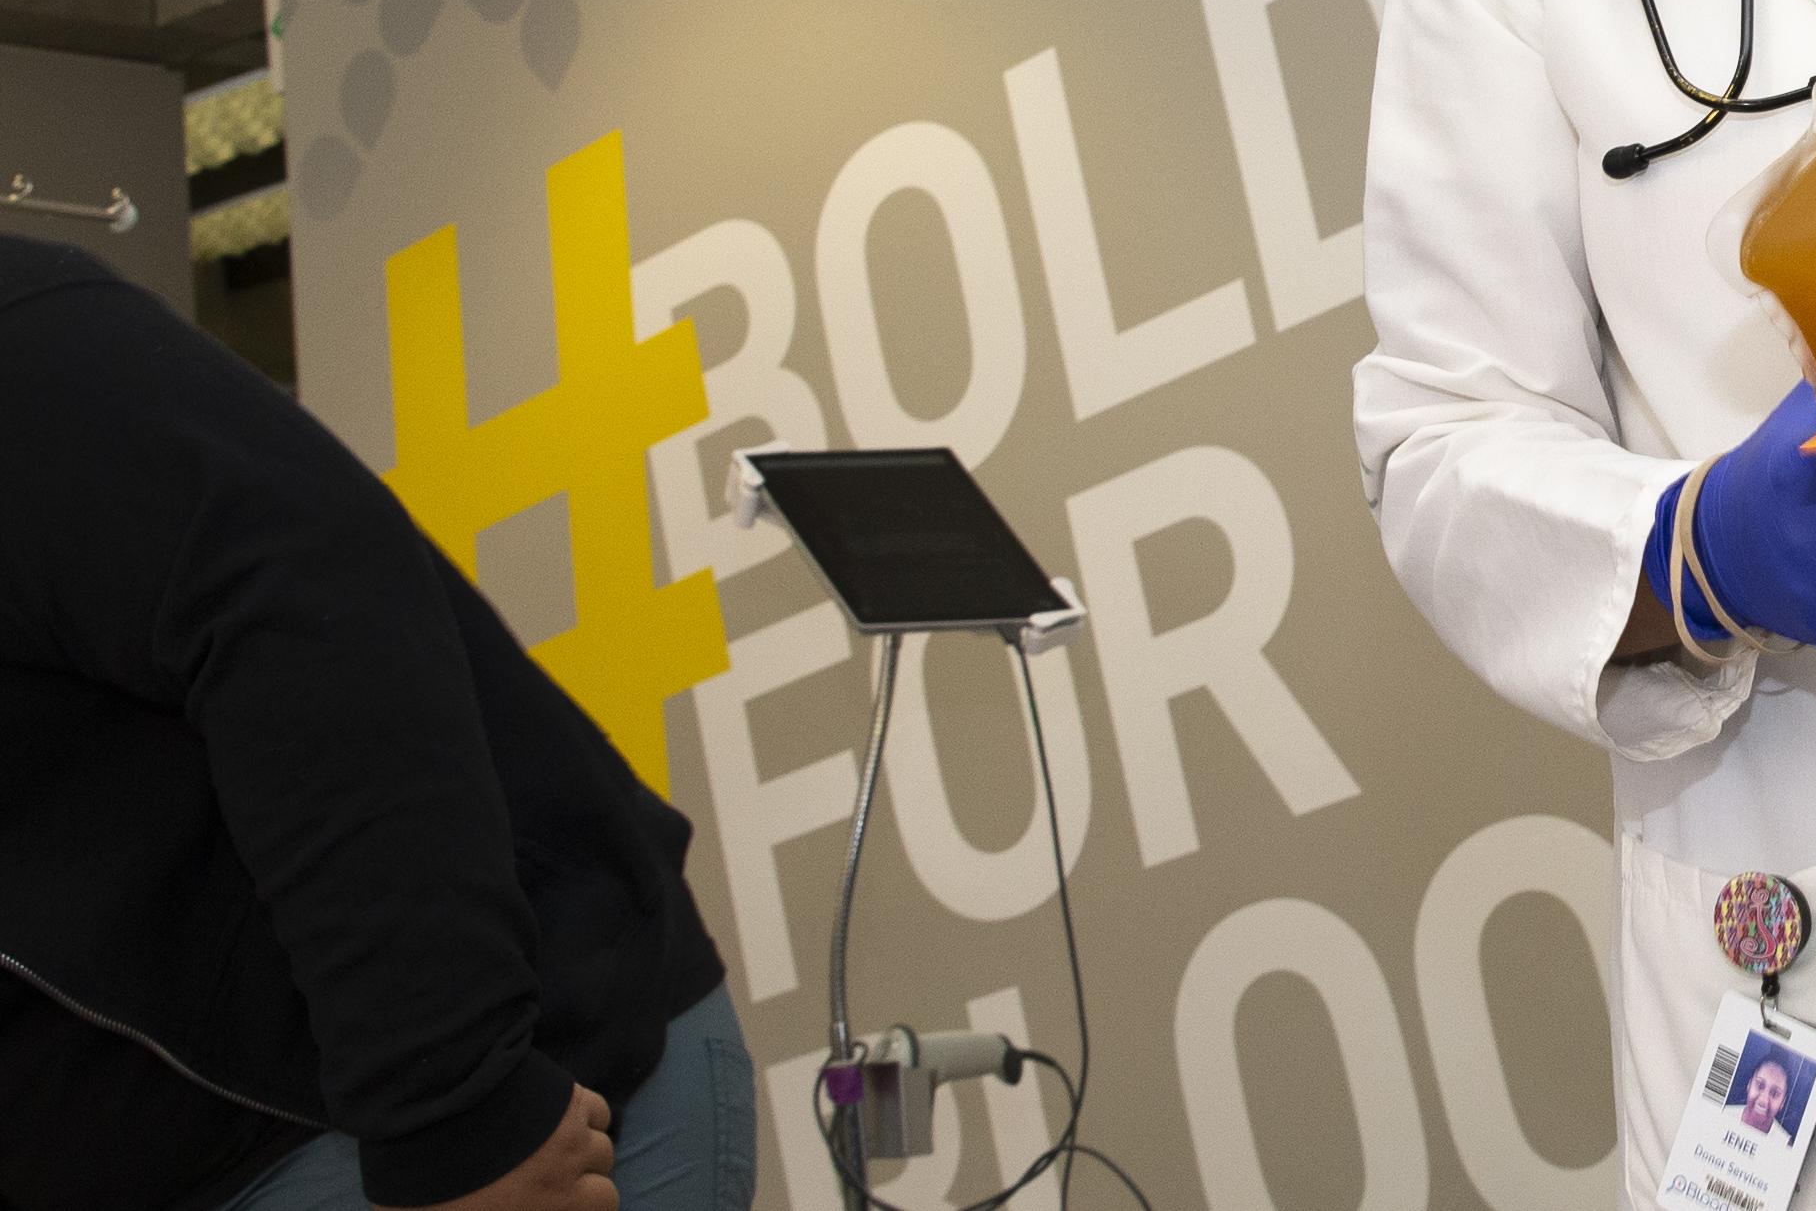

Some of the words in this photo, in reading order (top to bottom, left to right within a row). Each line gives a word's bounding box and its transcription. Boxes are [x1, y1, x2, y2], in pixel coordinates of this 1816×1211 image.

[684, 444, 1361, 1002] FOR
[1694, 1143, 1725, 1169] Donor
[1728, 1161, 1768, 1191] Services
[1722, 1129, 1758, 1157] JENEE
